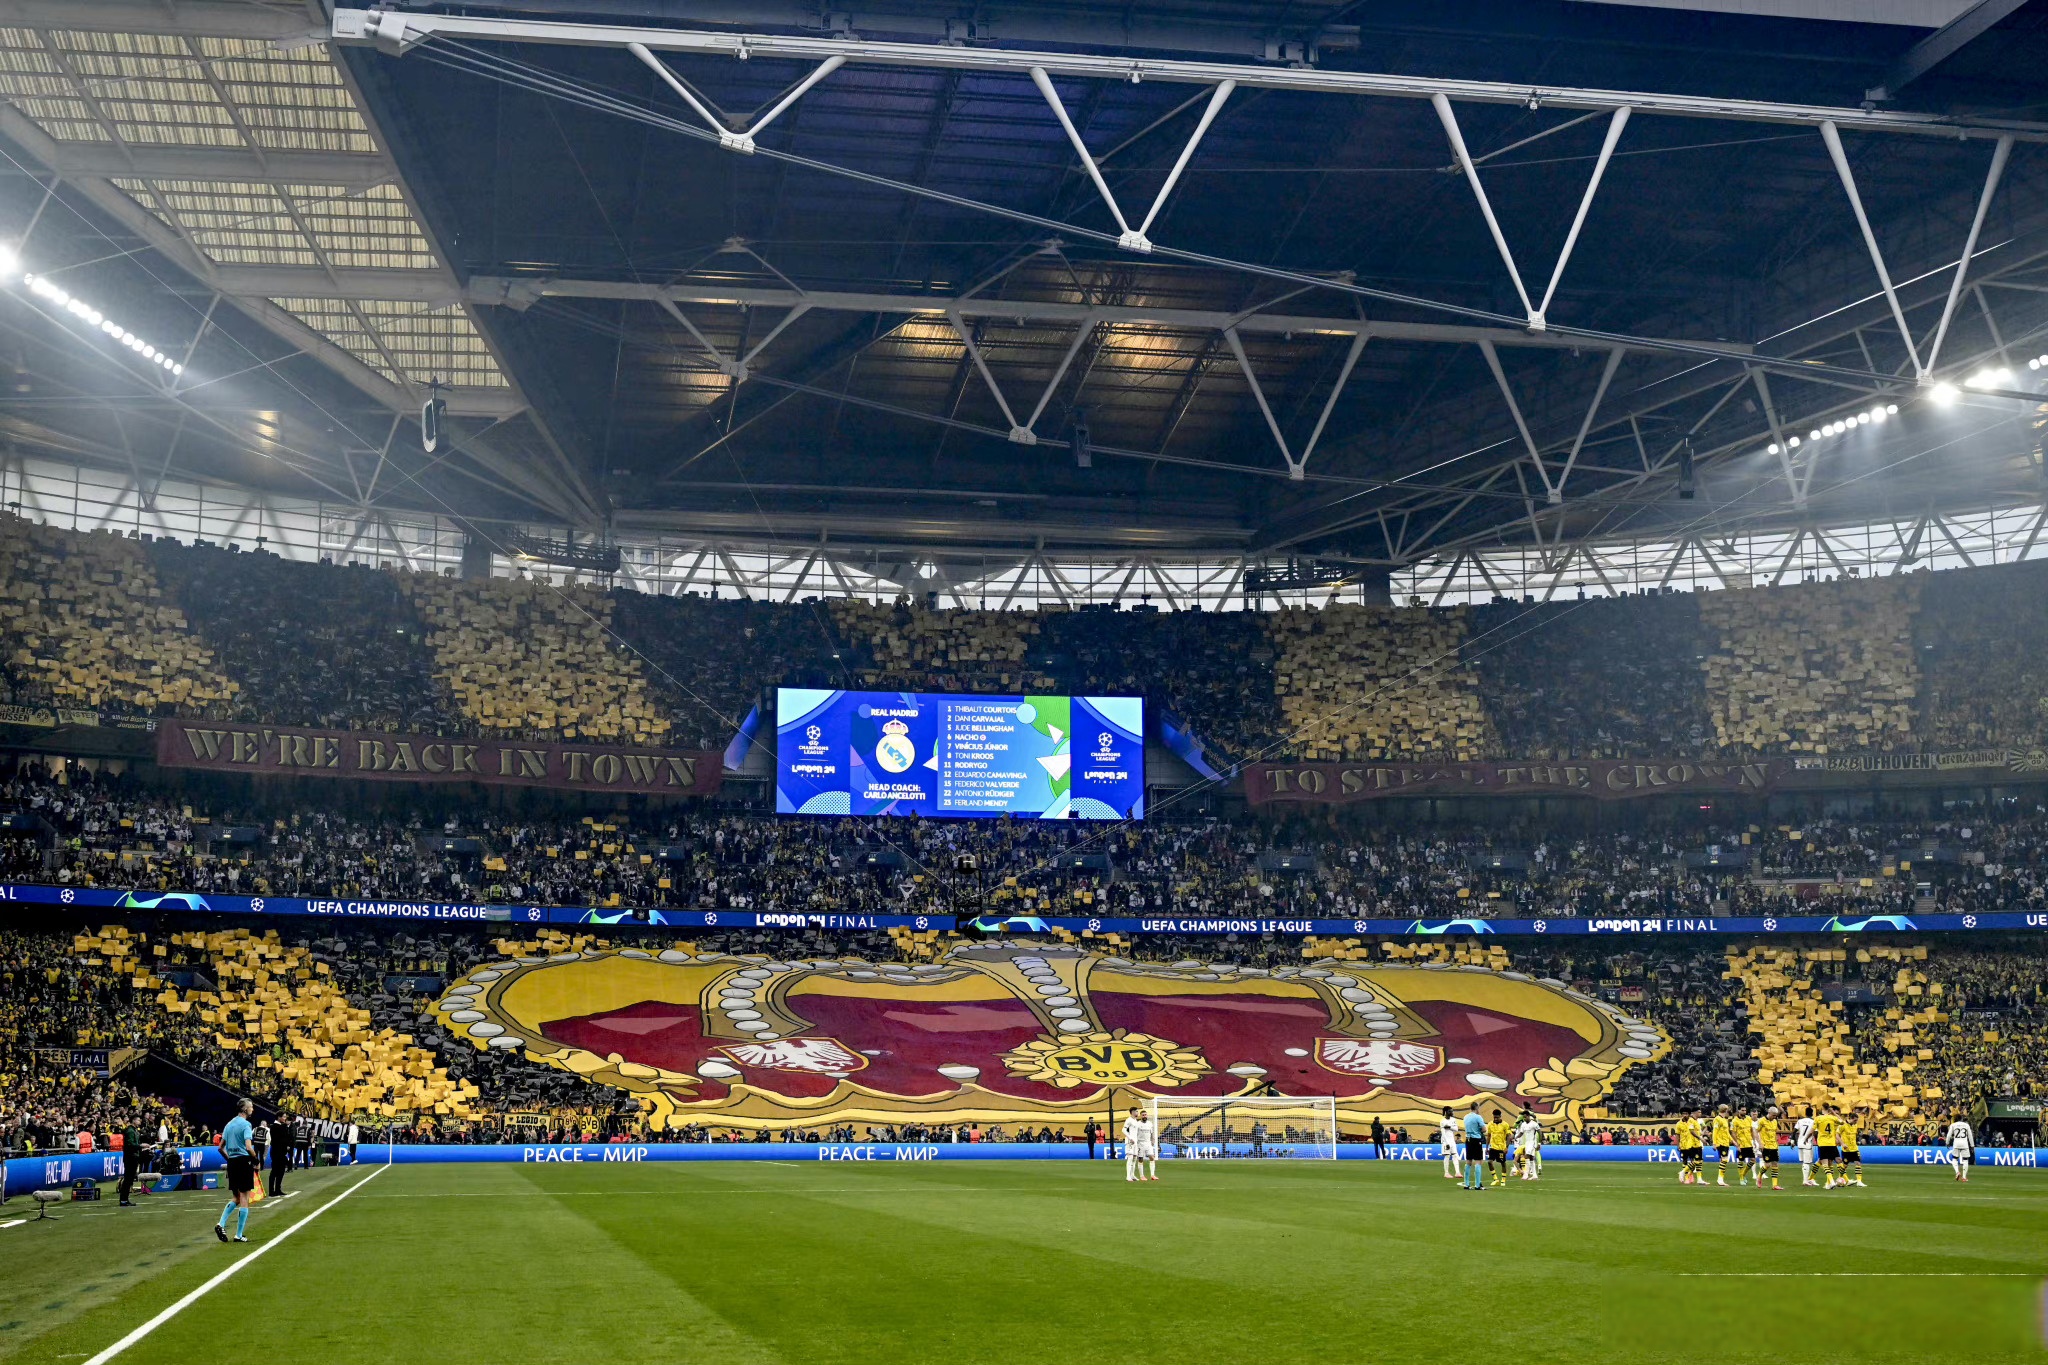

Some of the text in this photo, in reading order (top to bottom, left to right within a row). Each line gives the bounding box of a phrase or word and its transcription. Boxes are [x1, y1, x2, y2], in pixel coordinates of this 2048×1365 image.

[870, 708, 919, 718] REAL MADRID
[954, 705, 982, 713] THIBAUT
[983, 706, 1017, 714] COURTOIS
[971, 715, 1006, 723] CARVAJAL
[954, 724, 971, 732] JUDE
[954, 733, 979, 741] NACHO
[954, 742, 984, 751] VINÍCIUS
[984, 742, 1009, 751] JÚNIOR
[183, 728, 697, 787] WE'RE BACK IN TOWN
[954, 752, 971, 760] TONI
[823, 765, 836, 774] 24
[954, 761, 988, 769] RODRYGO
[954, 771, 986, 779] EDUARDO
[986, 771, 1028, 779] CAMAVINGA
[1115, 771, 1128, 780] 24
[1266, 769, 1327, 795] TO
[1498, 767, 1590, 788] THE
[1606, 763, 1769, 791] CROWN
[868, 783, 922, 792] HEAD COACH:
[954, 780, 985, 788] FEDERICO
[863, 791, 926, 800] CARLO ANCELOTTI
[954, 790, 984, 798] ANTONIO
[985, 789, 1015, 798] RÜDIGER
[954, 799, 984, 807] FERLAND
[983, 799, 1008, 808] MENDY
[307, 900, 486, 919] UEFA CHAMPIONS LEAGUE
[829, 915, 877, 928] FINAL
[1142, 920, 1313, 932] UEFA CHAMPIONS LEAGUE
[1642, 919, 1662, 932] 24
[1666, 919, 1718, 931] FINAL
[73, 1054, 107, 1064] FINAL
[1054, 1045, 1158, 1072] BVB
[1093, 1070, 1128, 1078] 09
[515, 1115, 538, 1124] LEGIO
[581, 1116, 598, 1130] BVB
[1802, 1124, 1809, 1136] 7
[1824, 1122, 1832, 1134] 4
[1953, 1127, 1968, 1138] 23
[524, 1147, 584, 1162] PEACE
[603, 1147, 648, 1162] МИР
[818, 1146, 876, 1161] PEACE
[895, 1146, 939, 1161] МИР
[1380, 1147, 1433, 1160] PEACE
[1913, 1149, 1964, 1164] PEAC
[1995, 1151, 2035, 1166] МИР
